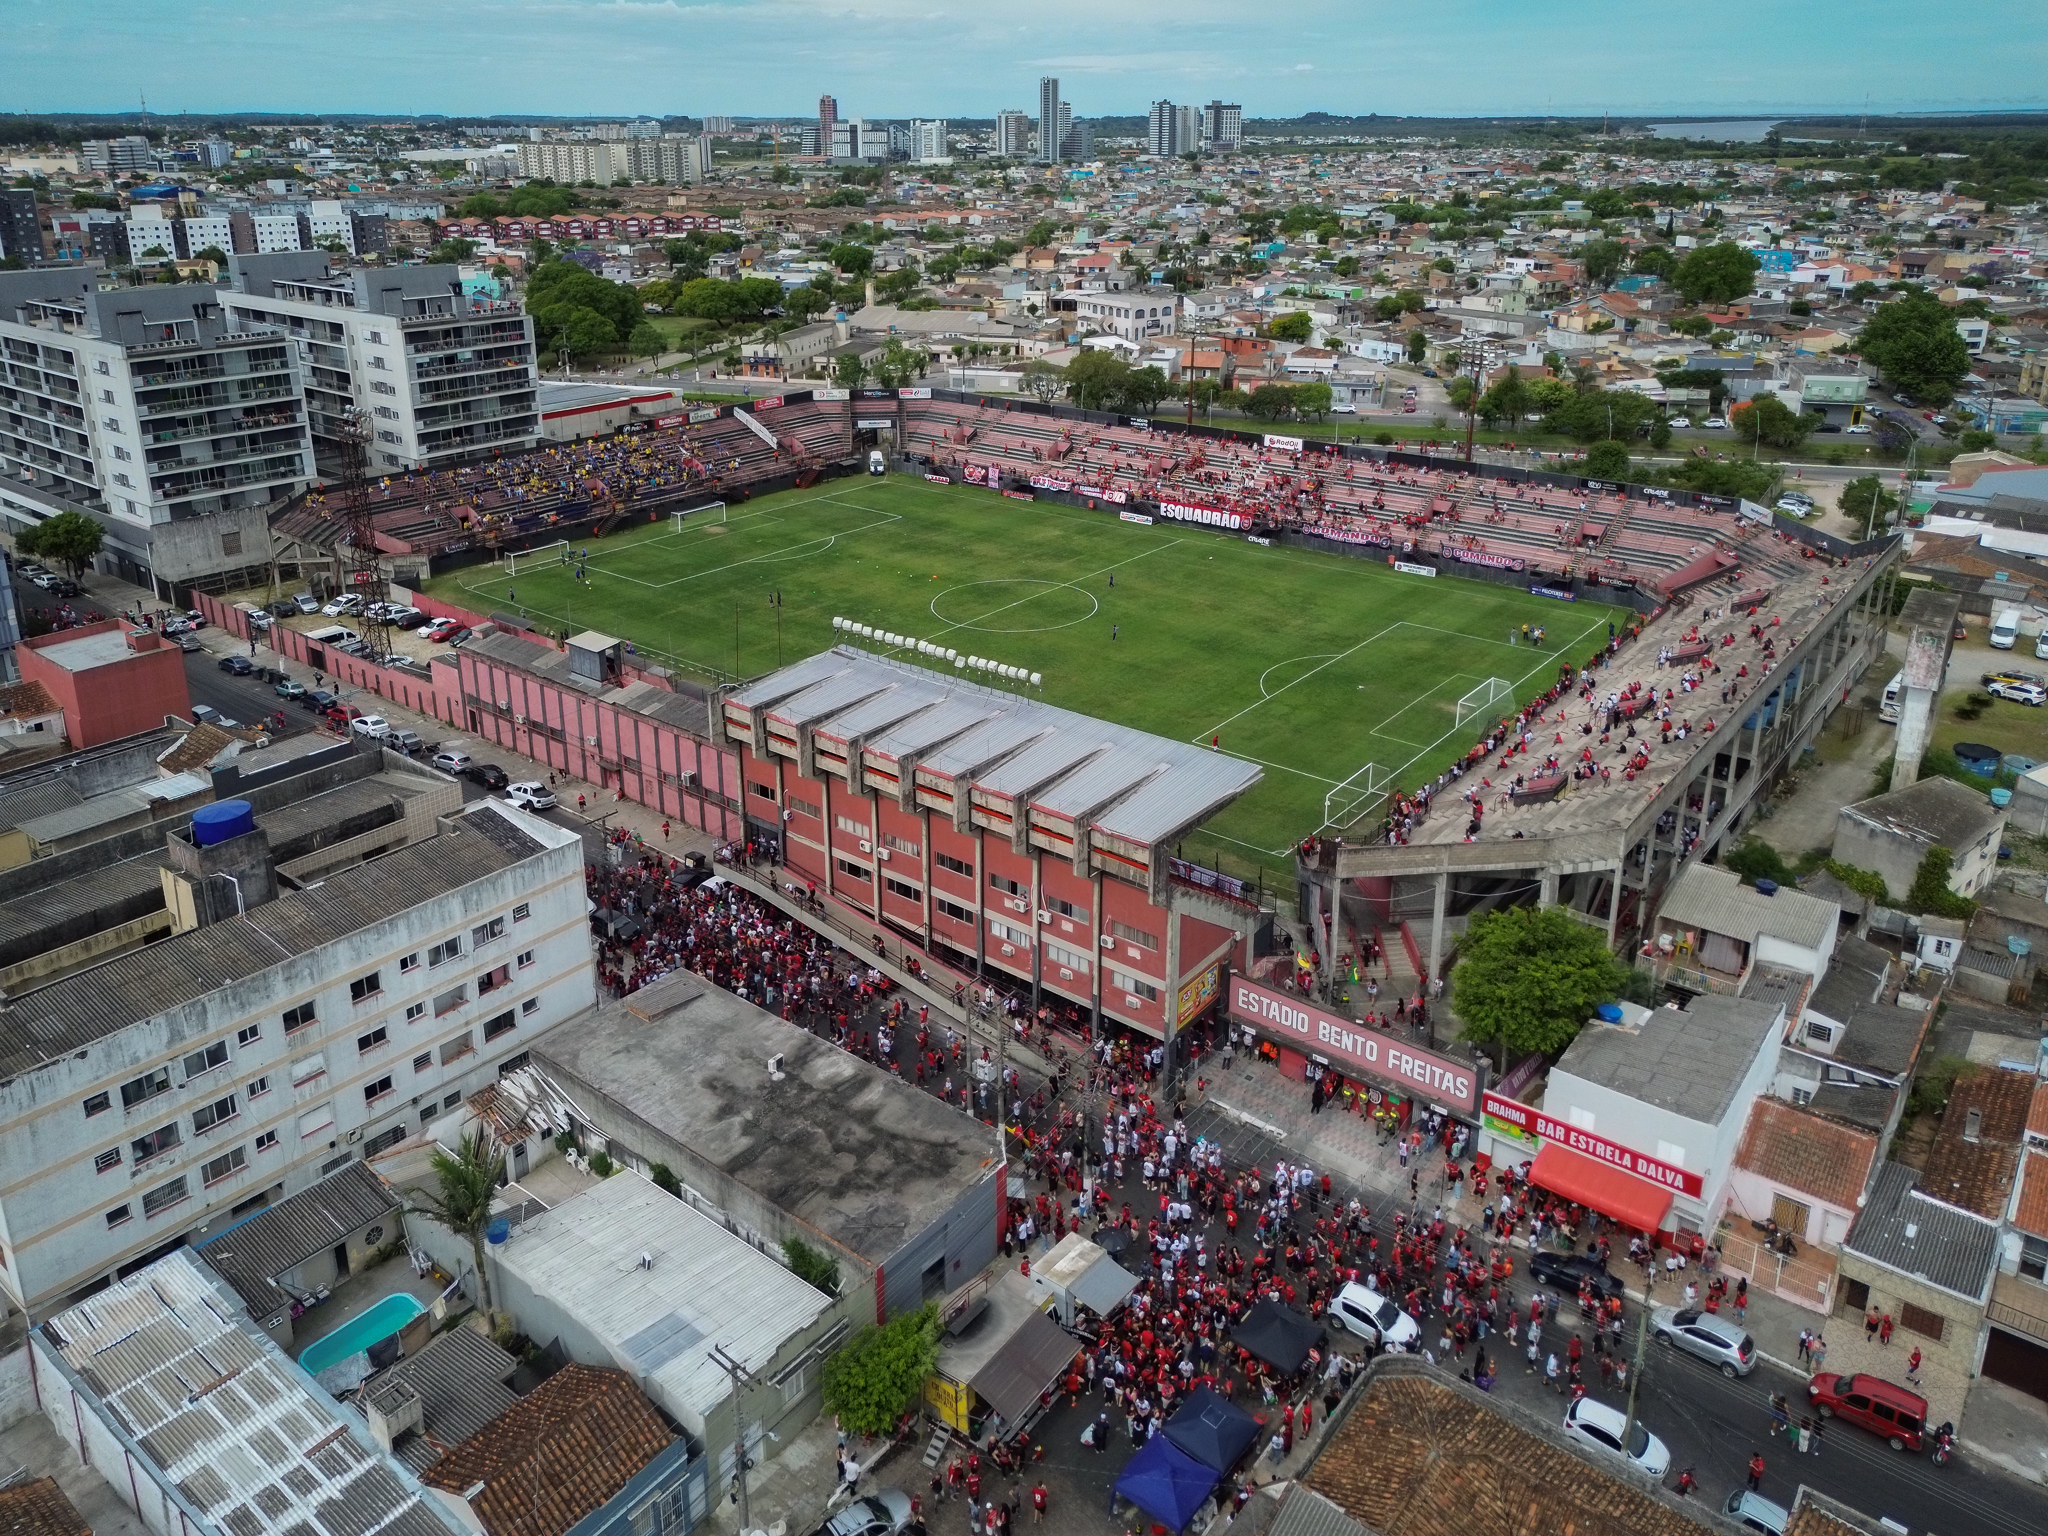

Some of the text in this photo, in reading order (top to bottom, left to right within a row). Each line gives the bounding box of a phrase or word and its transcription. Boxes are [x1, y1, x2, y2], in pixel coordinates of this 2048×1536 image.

[1160, 501, 1241, 530] ESQUADRÃO
[1311, 525, 1381, 544] COMANDO
[1453, 548, 1513, 567] COMANDO
[1238, 987, 1309, 1034] ESTÁDIO
[1318, 1020, 1378, 1062] BENTO
[1387, 1048, 1469, 1099] FREITAS
[1486, 1100, 1526, 1125] BRAHMA
[1537, 1118, 1565, 1142] BAR
[1569, 1131, 1632, 1169] ESTRELA
[1637, 1151, 1685, 1190] DALVA
